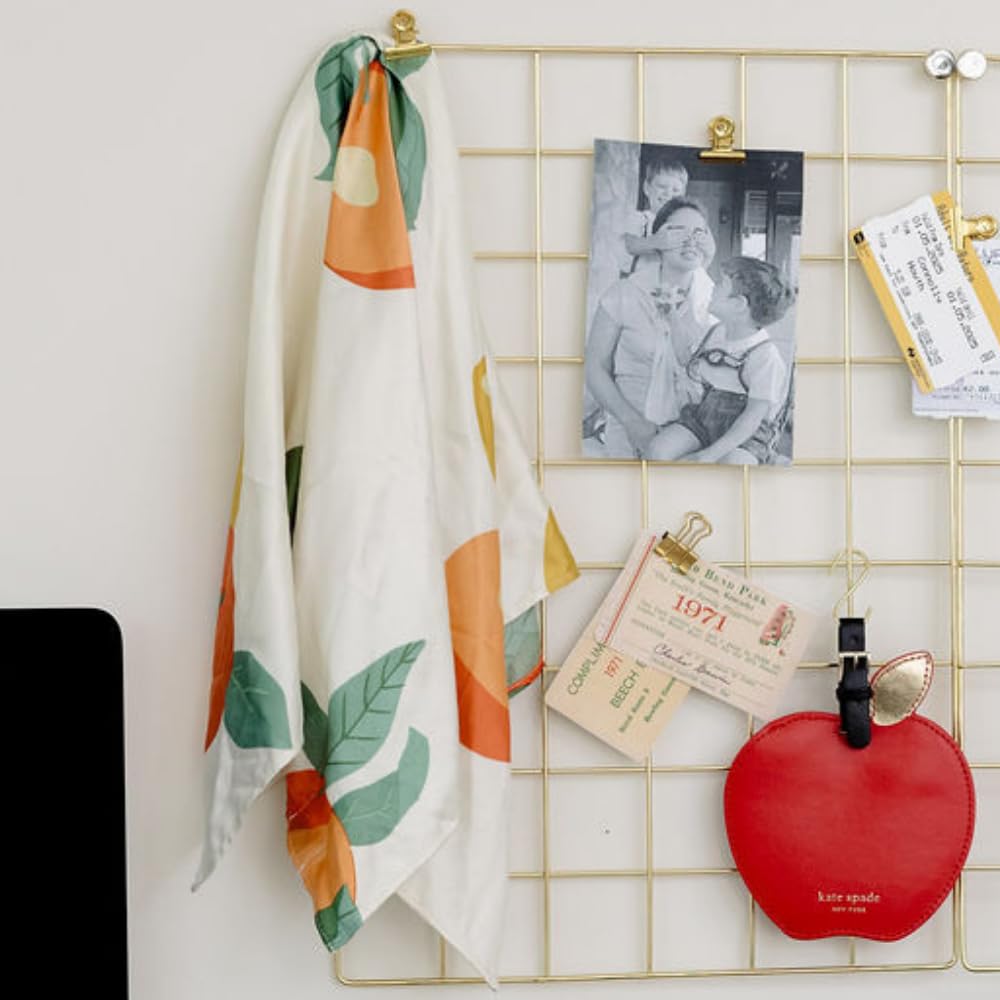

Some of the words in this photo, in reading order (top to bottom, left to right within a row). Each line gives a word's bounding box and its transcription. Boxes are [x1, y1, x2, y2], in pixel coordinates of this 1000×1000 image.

[672, 593, 728, 632] 1971
[609, 669, 641, 709] BEECH
[817, 891, 843, 902] kate
[846, 891, 881, 904] spade
